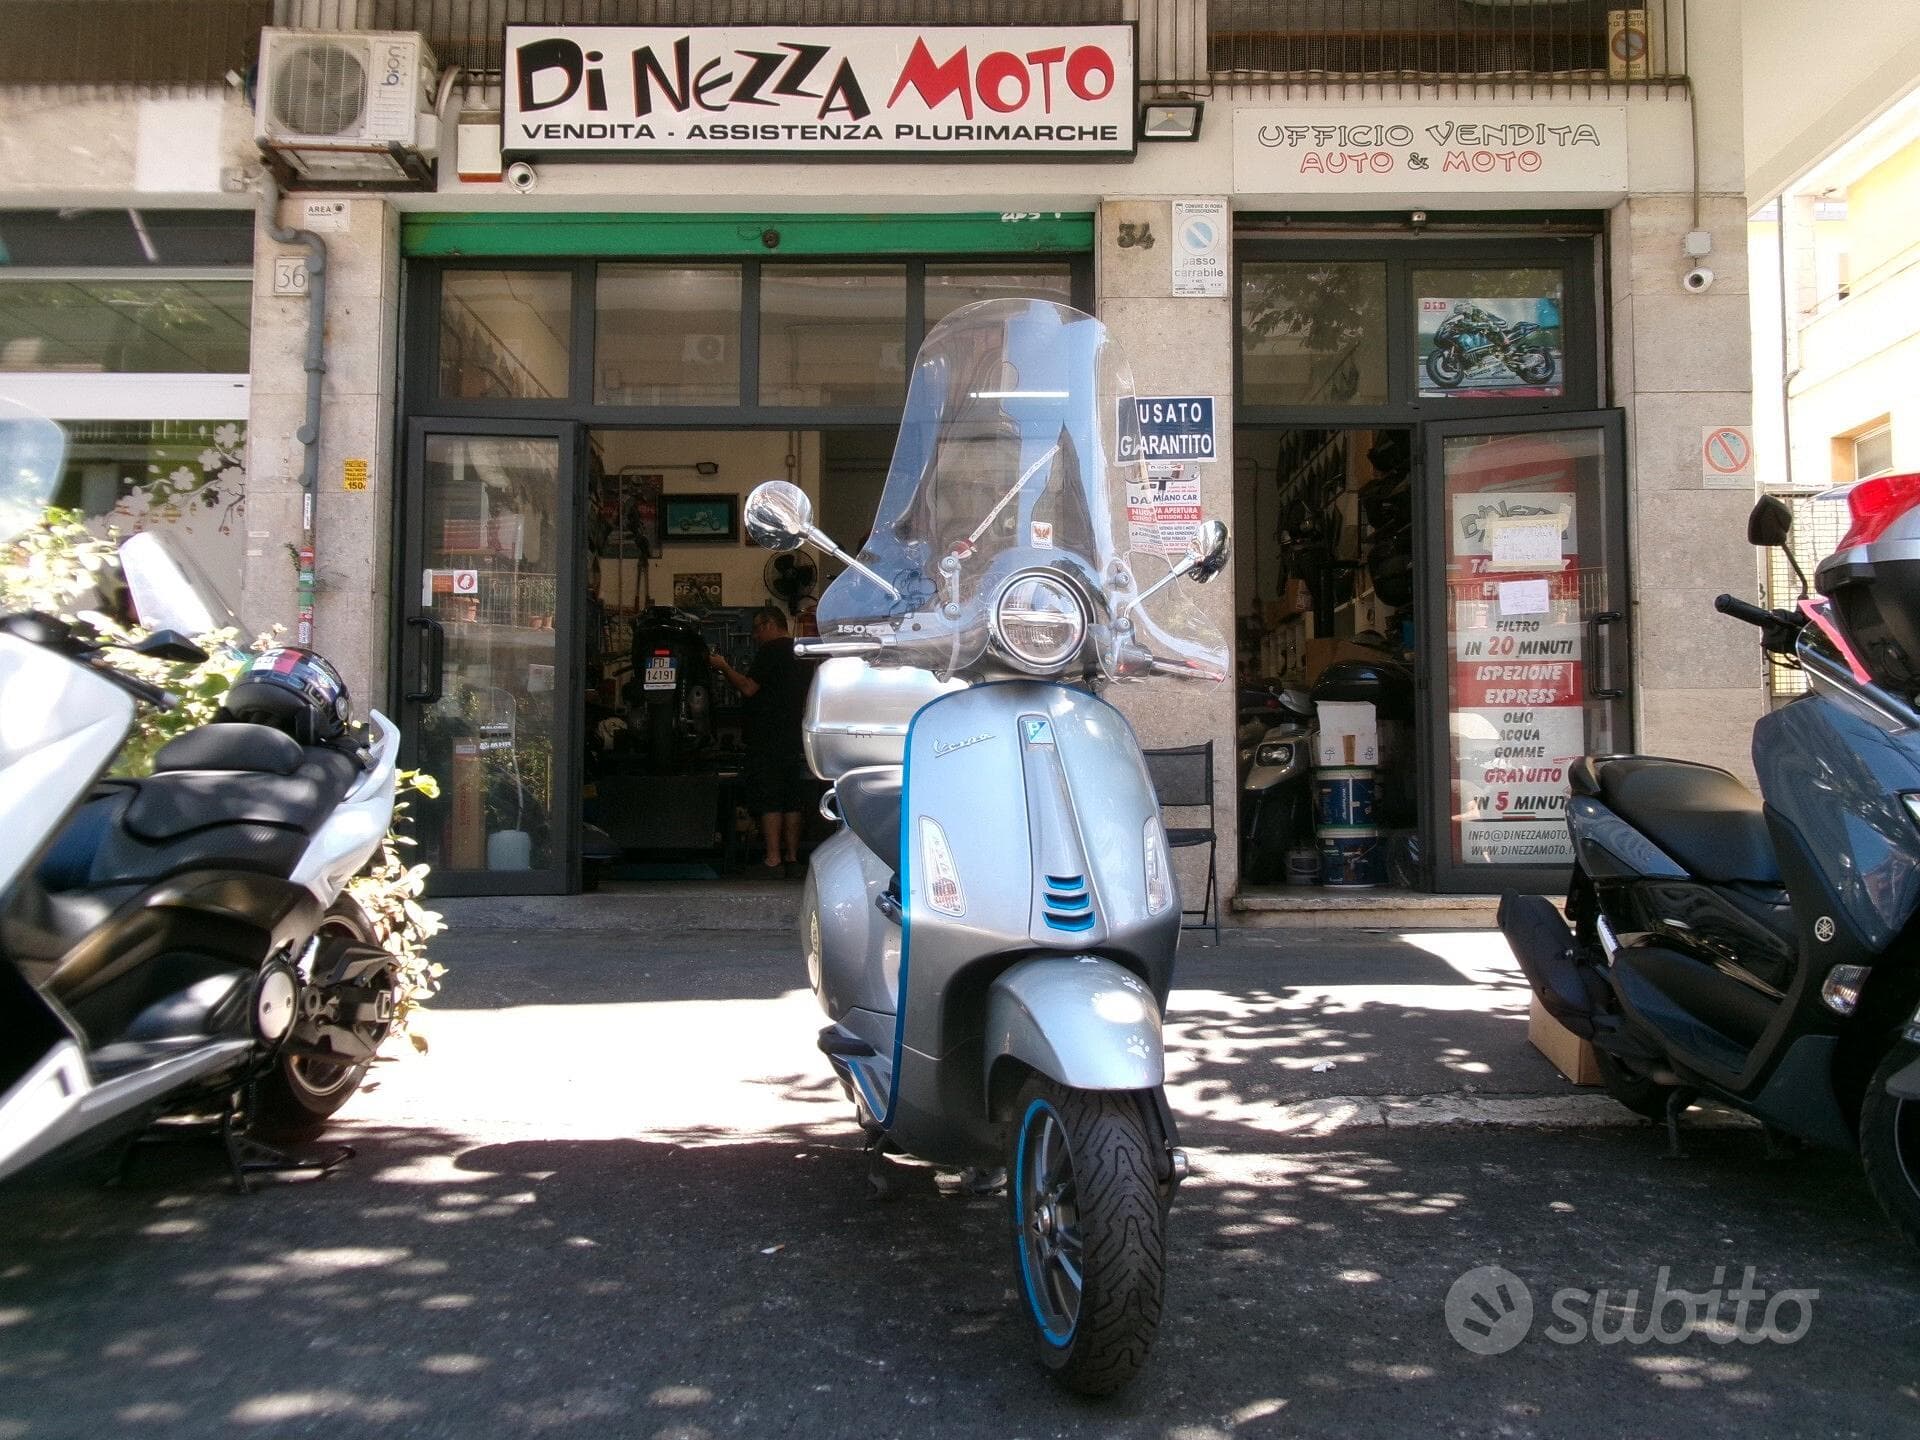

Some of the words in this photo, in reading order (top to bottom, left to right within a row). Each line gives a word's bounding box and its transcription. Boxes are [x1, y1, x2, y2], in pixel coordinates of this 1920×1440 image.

[516, 38, 608, 112] Di
[886, 35, 1114, 121] MOTO
[521, 124, 656, 139] VENDITA
[686, 124, 884, 140] ASSISTENZA
[895, 124, 1117, 140] PLURIMARCHE
[1258, 124, 1414, 147] UFFICIO
[1425, 121, 1600, 147] VENDITA
[1300, 151, 1394, 174] AUTO
[1407, 152, 1430, 171] &
[1442, 150, 1543, 173] MOTO
[308, 205, 332, 213] AREA
[1183, 257, 1216, 267] passo
[278, 264, 305, 288] 36
[1174, 268, 1224, 277] carrabile
[1140, 403, 1201, 422] USATO
[1495, 620, 1540, 632] FILTRO
[1464, 641, 1482, 655] IN
[1488, 635, 1514, 656] 20
[1518, 640, 1573, 655] MINUTI
[647, 670, 673, 680] 14191
[1476, 665, 1563, 681] ISPEZIONE
[1485, 687, 1557, 704] EXPRESS
[1503, 711, 1534, 724] OLIO
[1499, 729, 1540, 742] ACQUA
[1495, 746, 1545, 758] GOMME
[1484, 768, 1561, 783] GRATUITO
[1495, 791, 1509, 811] 5
